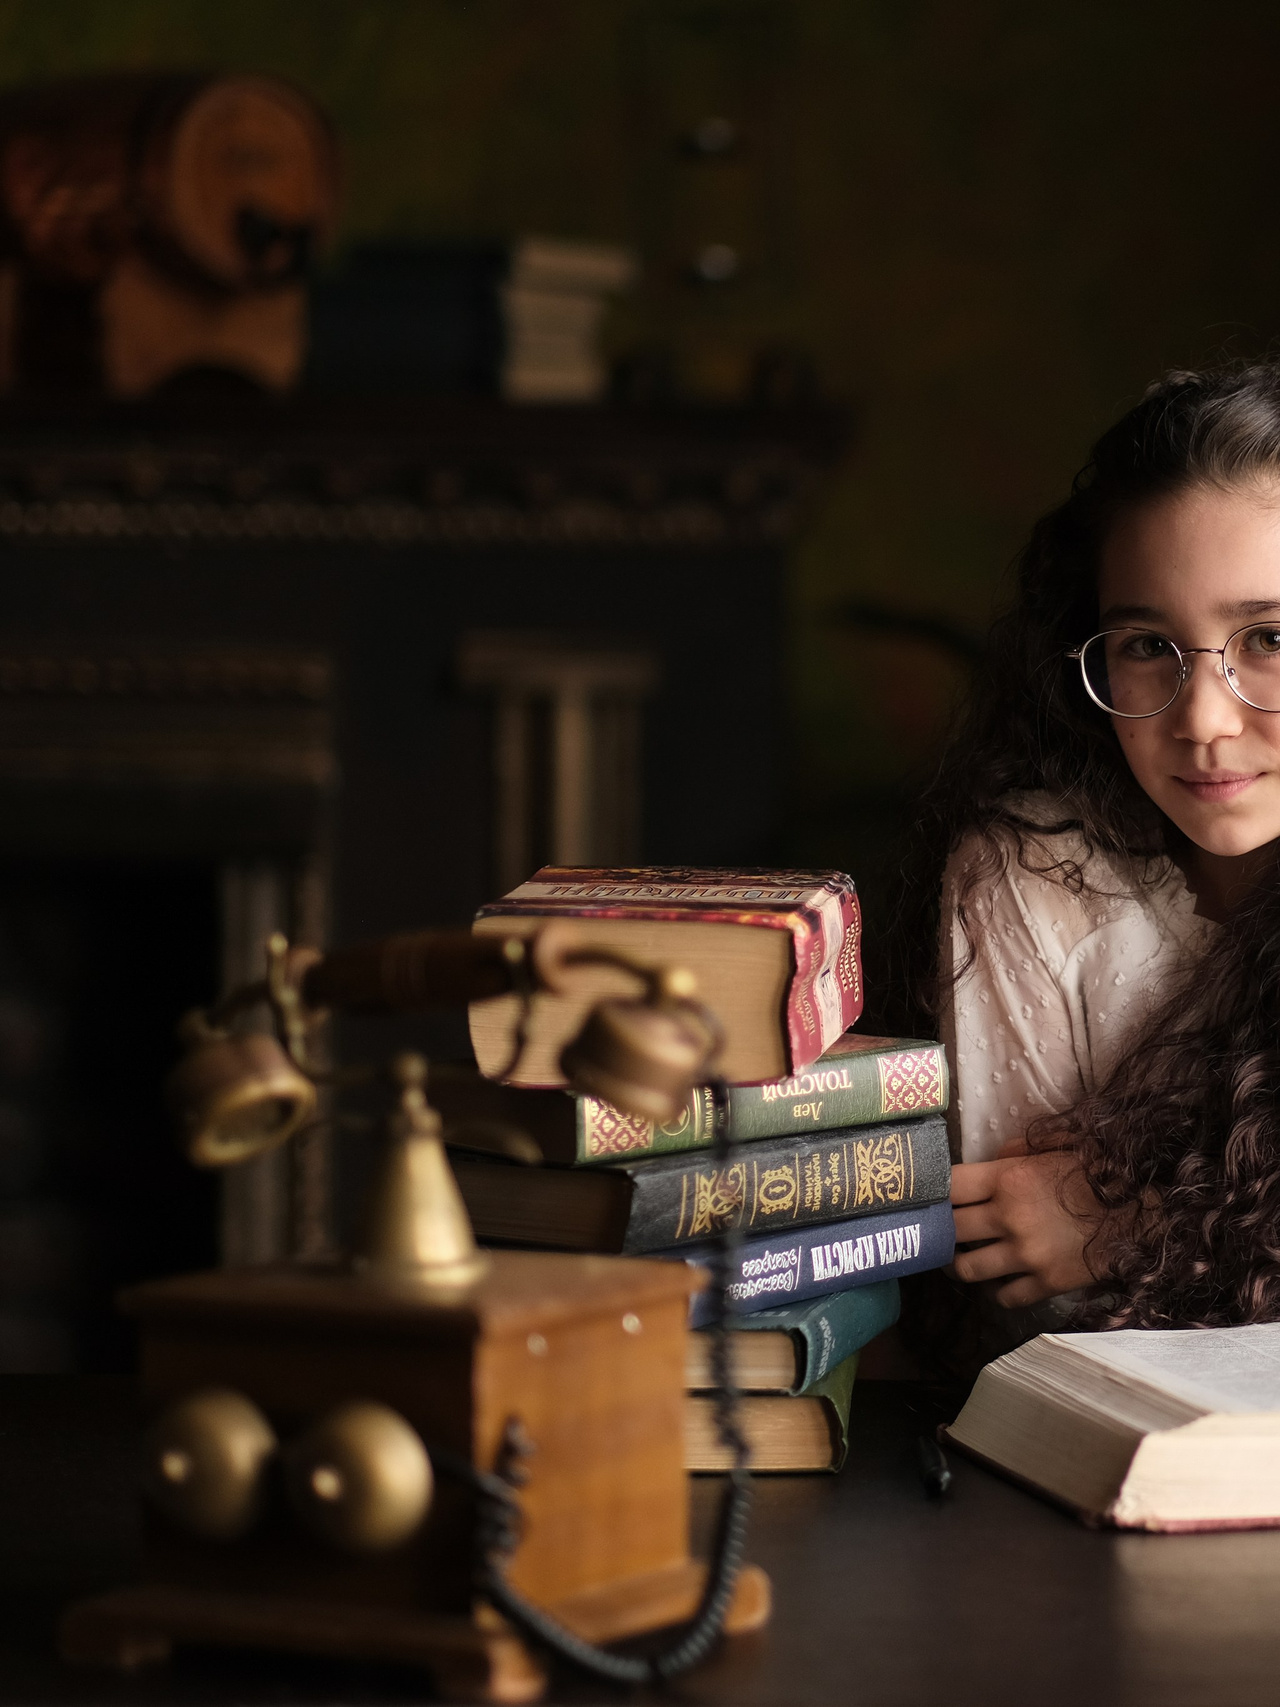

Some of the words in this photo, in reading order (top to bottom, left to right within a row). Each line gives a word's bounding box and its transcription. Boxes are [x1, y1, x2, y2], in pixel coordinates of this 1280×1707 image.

[762, 1069, 853, 1102] ТОЛСТОЙ
[793, 1101, 823, 1121] Лев
[804, 1162, 814, 1208] ТАЙНЫ
[812, 1153, 824, 1212] ПАРИЖСКИЕ
[831, 1184, 842, 1205] Сю
[810, 1234, 875, 1281] КРИСТИ
[874, 1223, 921, 1266] АГАТА
